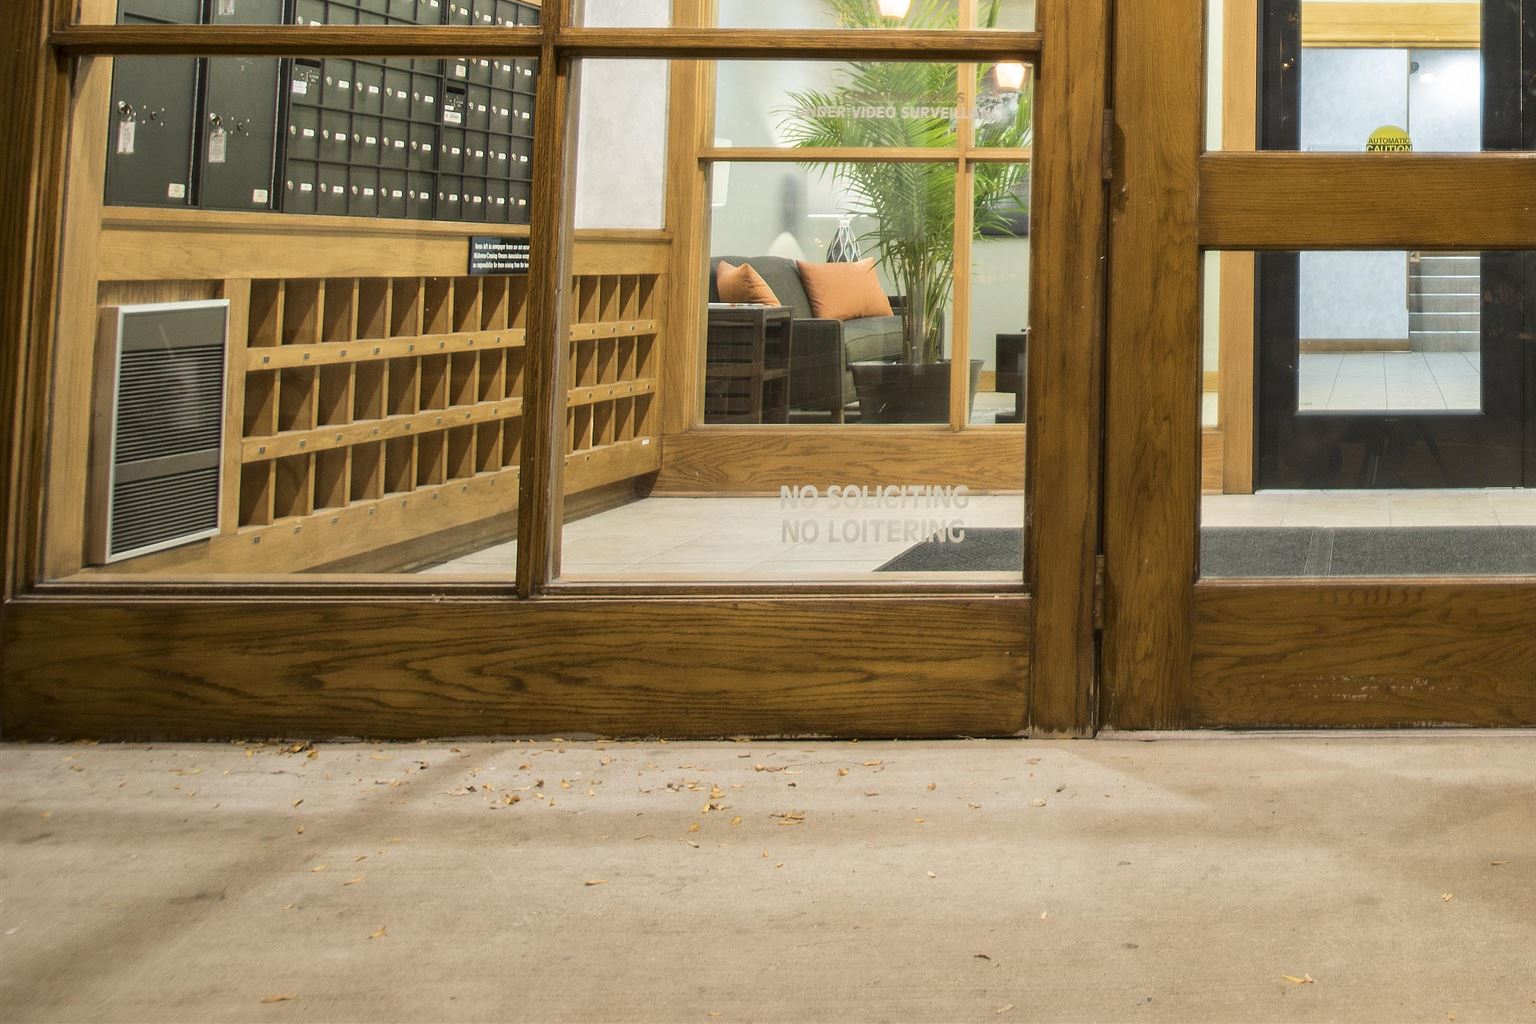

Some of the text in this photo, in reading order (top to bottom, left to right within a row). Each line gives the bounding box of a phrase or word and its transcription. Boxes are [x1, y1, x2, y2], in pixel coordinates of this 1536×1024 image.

[851, 106, 897, 119] VIDEO
[779, 484, 970, 510] NO SOLICITING
[781, 518, 966, 544] NO LOITERING
